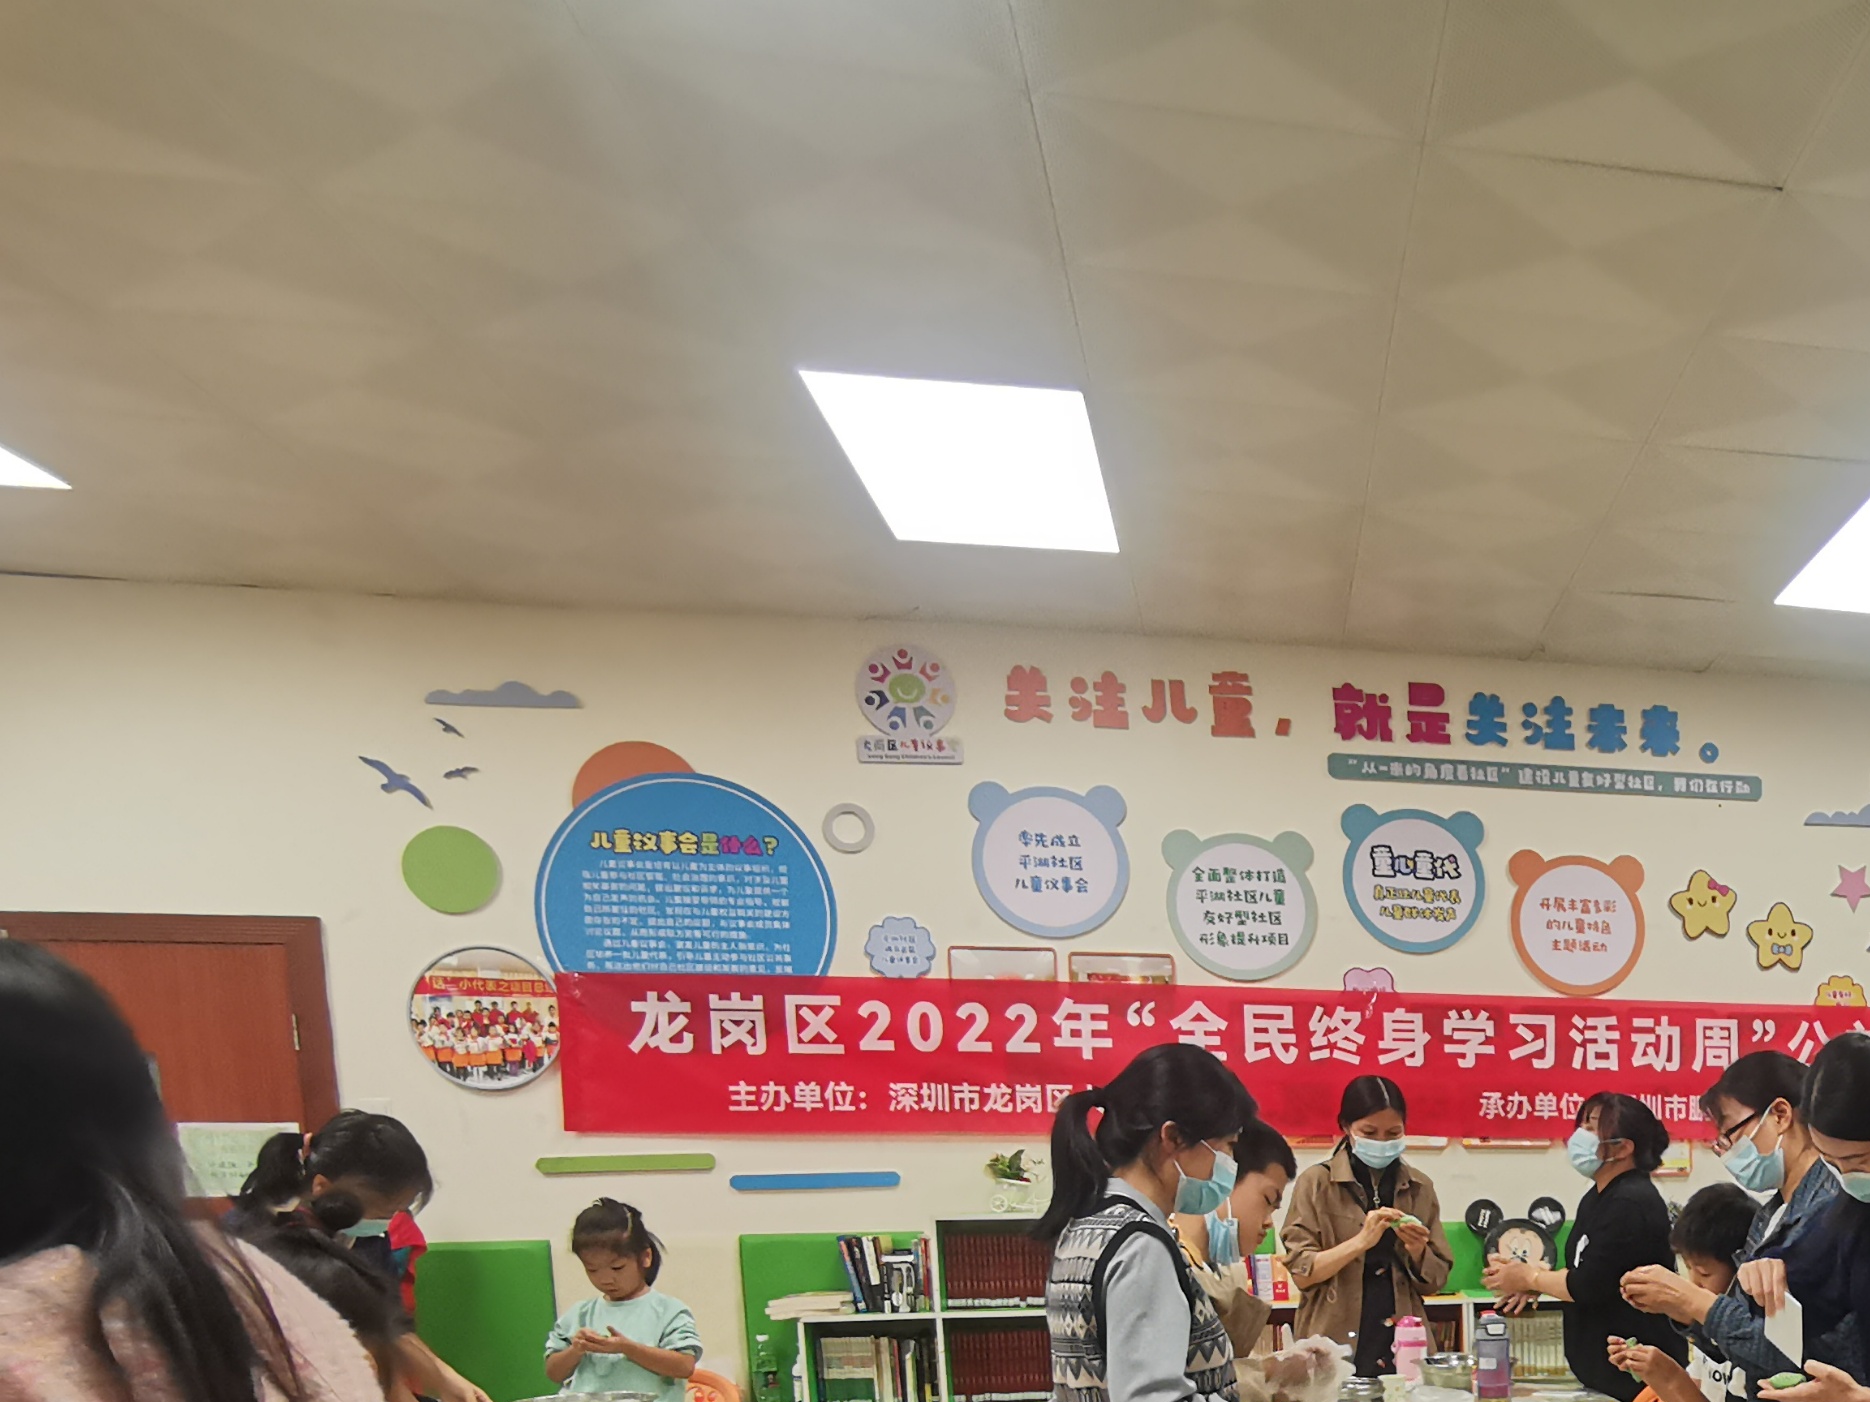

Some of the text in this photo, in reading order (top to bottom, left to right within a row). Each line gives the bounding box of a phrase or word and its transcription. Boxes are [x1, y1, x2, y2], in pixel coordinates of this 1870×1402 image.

[1018, 829, 1082, 849] 率先成立
[1018, 855, 1083, 871] 平湖社区
[1191, 866, 1287, 884] 全面整体打造
[1014, 875, 1089, 894] 儿童议事会
[1196, 889, 1286, 906] 平湖社区儿童
[1539, 896, 1617, 915] 开展丰富多彩
[1203, 910, 1283, 926] 友好型社区
[1546, 917, 1613, 936] 的儿童特色
[1551, 938, 1608, 953] 主题活动
[728, 1082, 1105, 1114] 主办单位：深圳市龙岗区
